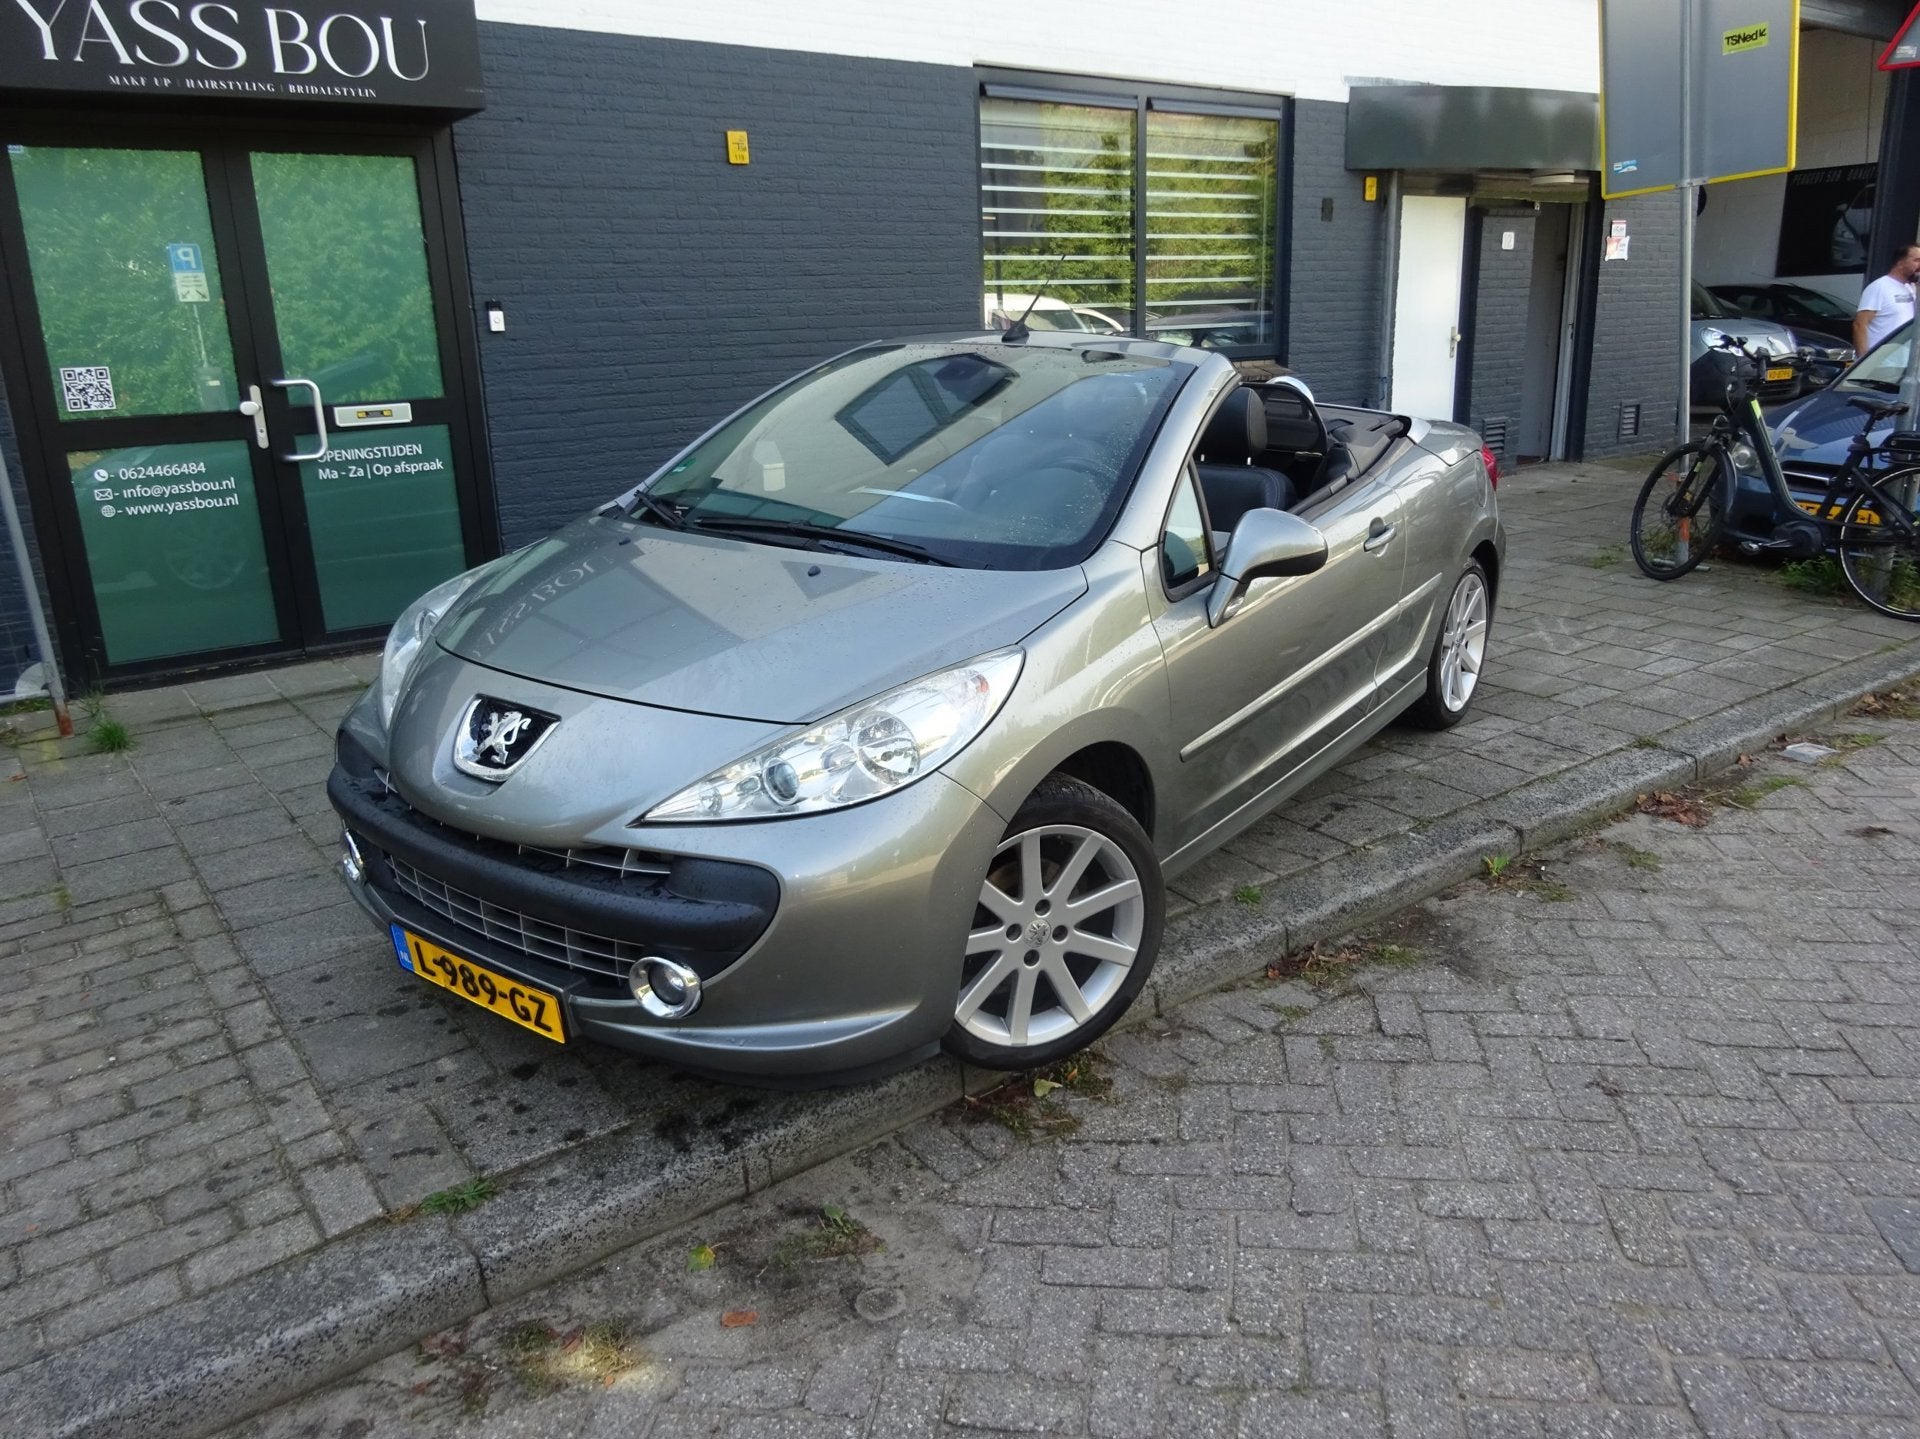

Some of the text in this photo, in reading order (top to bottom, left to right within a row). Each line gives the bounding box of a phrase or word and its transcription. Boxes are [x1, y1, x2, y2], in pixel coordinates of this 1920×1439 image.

[16, 0, 430, 82] YASS BOU
[154, 77, 171, 88] UP
[185, 78, 275, 93] HAIRSTYLING
[119, 462, 206, 480] 0624466484
[318, 468, 338, 480] Ma
[348, 466, 364, 478] Za
[373, 464, 392, 477] Op
[394, 458, 444, 475] afspraak
[123, 477, 236, 499] info@yassbou.nl
[125, 493, 239, 515] www.yassbou.nl
[414, 940, 553, 1033] L-989-GZ
